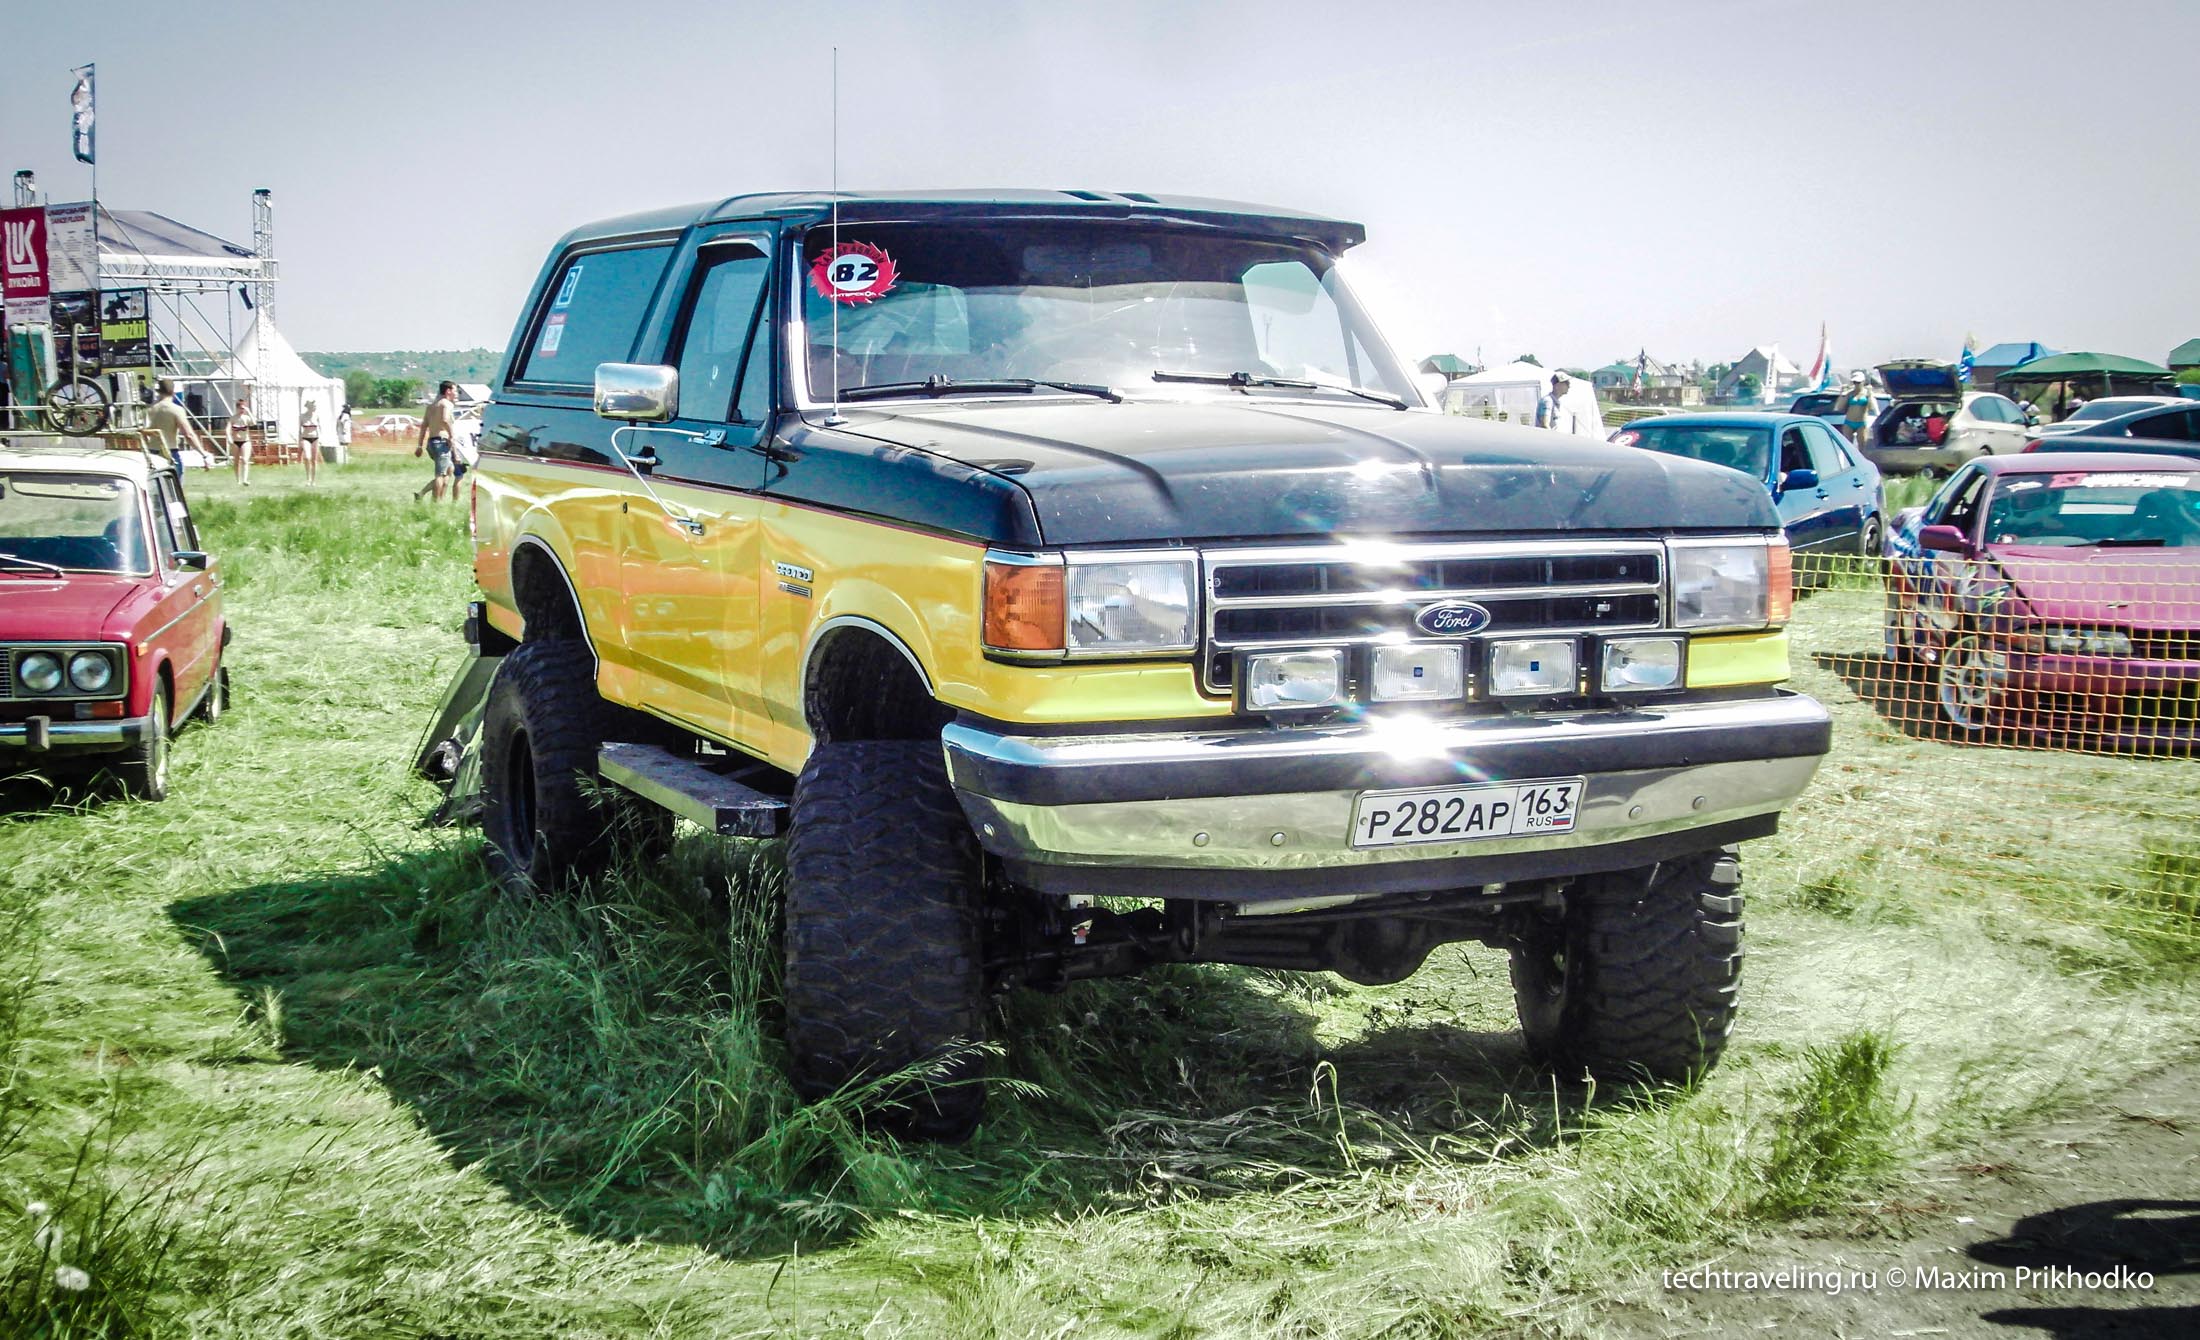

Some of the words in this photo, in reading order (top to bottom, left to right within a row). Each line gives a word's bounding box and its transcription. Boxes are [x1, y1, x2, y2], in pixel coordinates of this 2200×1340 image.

[831, 263, 879, 281] 82
[1433, 609, 1473, 628] Ford
[1521, 787, 1571, 817] 163
[1526, 816, 1552, 827] RUS
